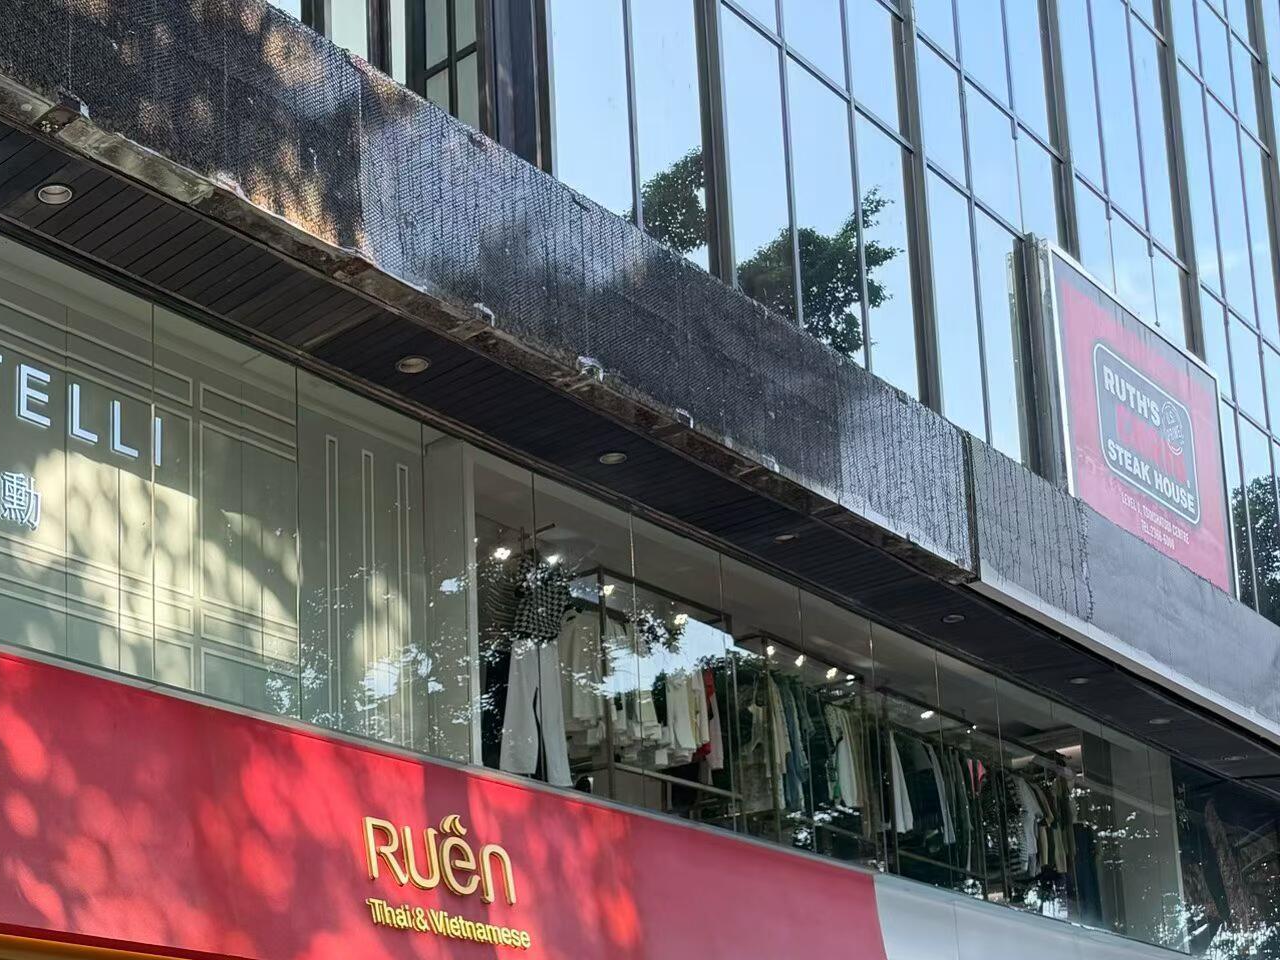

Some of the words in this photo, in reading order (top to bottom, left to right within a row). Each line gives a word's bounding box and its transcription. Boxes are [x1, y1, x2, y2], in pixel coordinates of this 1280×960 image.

[1103, 365, 1161, 427] RUTH'S
[1107, 438, 1152, 485] STEAK
[1153, 469, 1196, 514] HOUSE
[366, 897, 412, 930] Thai
[413, 907, 428, 932] &
[428, 908, 532, 950] Vietnamese
